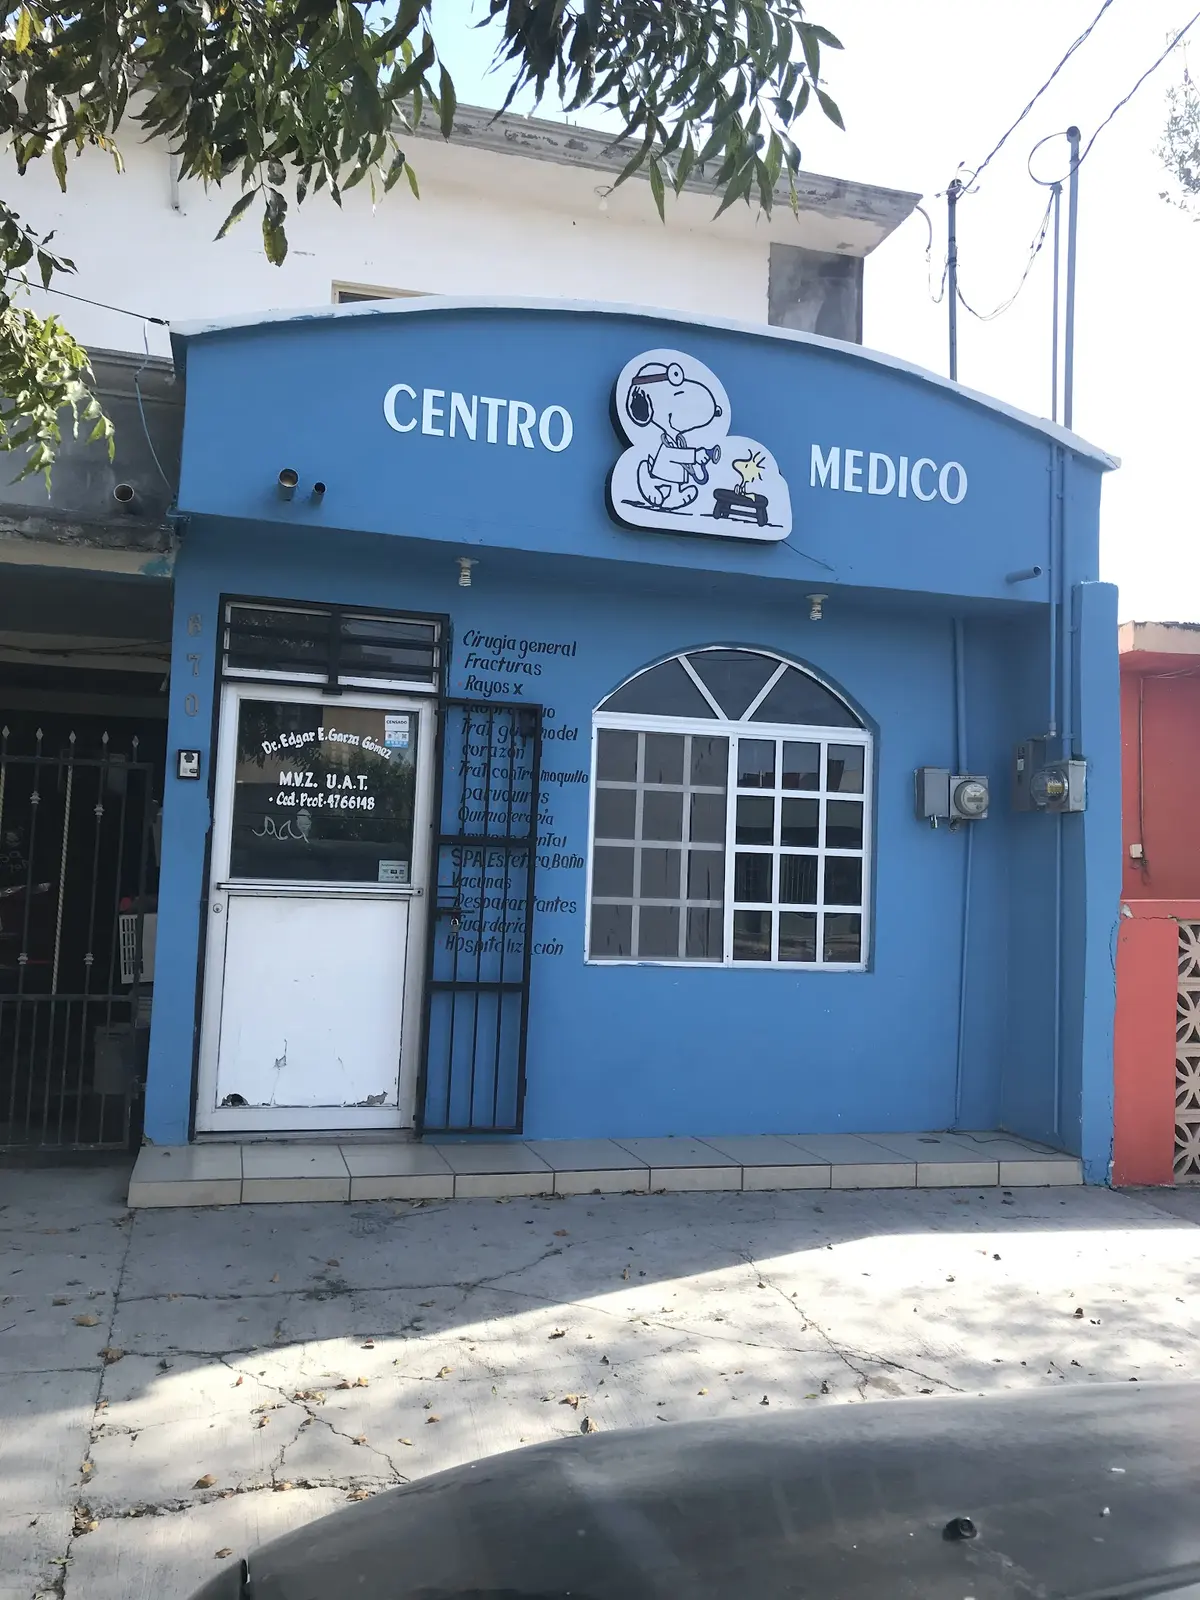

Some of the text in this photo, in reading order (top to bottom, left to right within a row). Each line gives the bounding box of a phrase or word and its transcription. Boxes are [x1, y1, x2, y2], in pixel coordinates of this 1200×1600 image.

[383, 382, 970, 505] CENTRO MEDICO
[463, 629, 577, 659] Cirugia general
[464, 652, 542, 676] Fracturas
[464, 674, 510, 698] Rayos
[279, 730, 315, 749] Edgar
[361, 736, 391, 760] Gómez
[326, 774, 368, 790] U.A.T.
